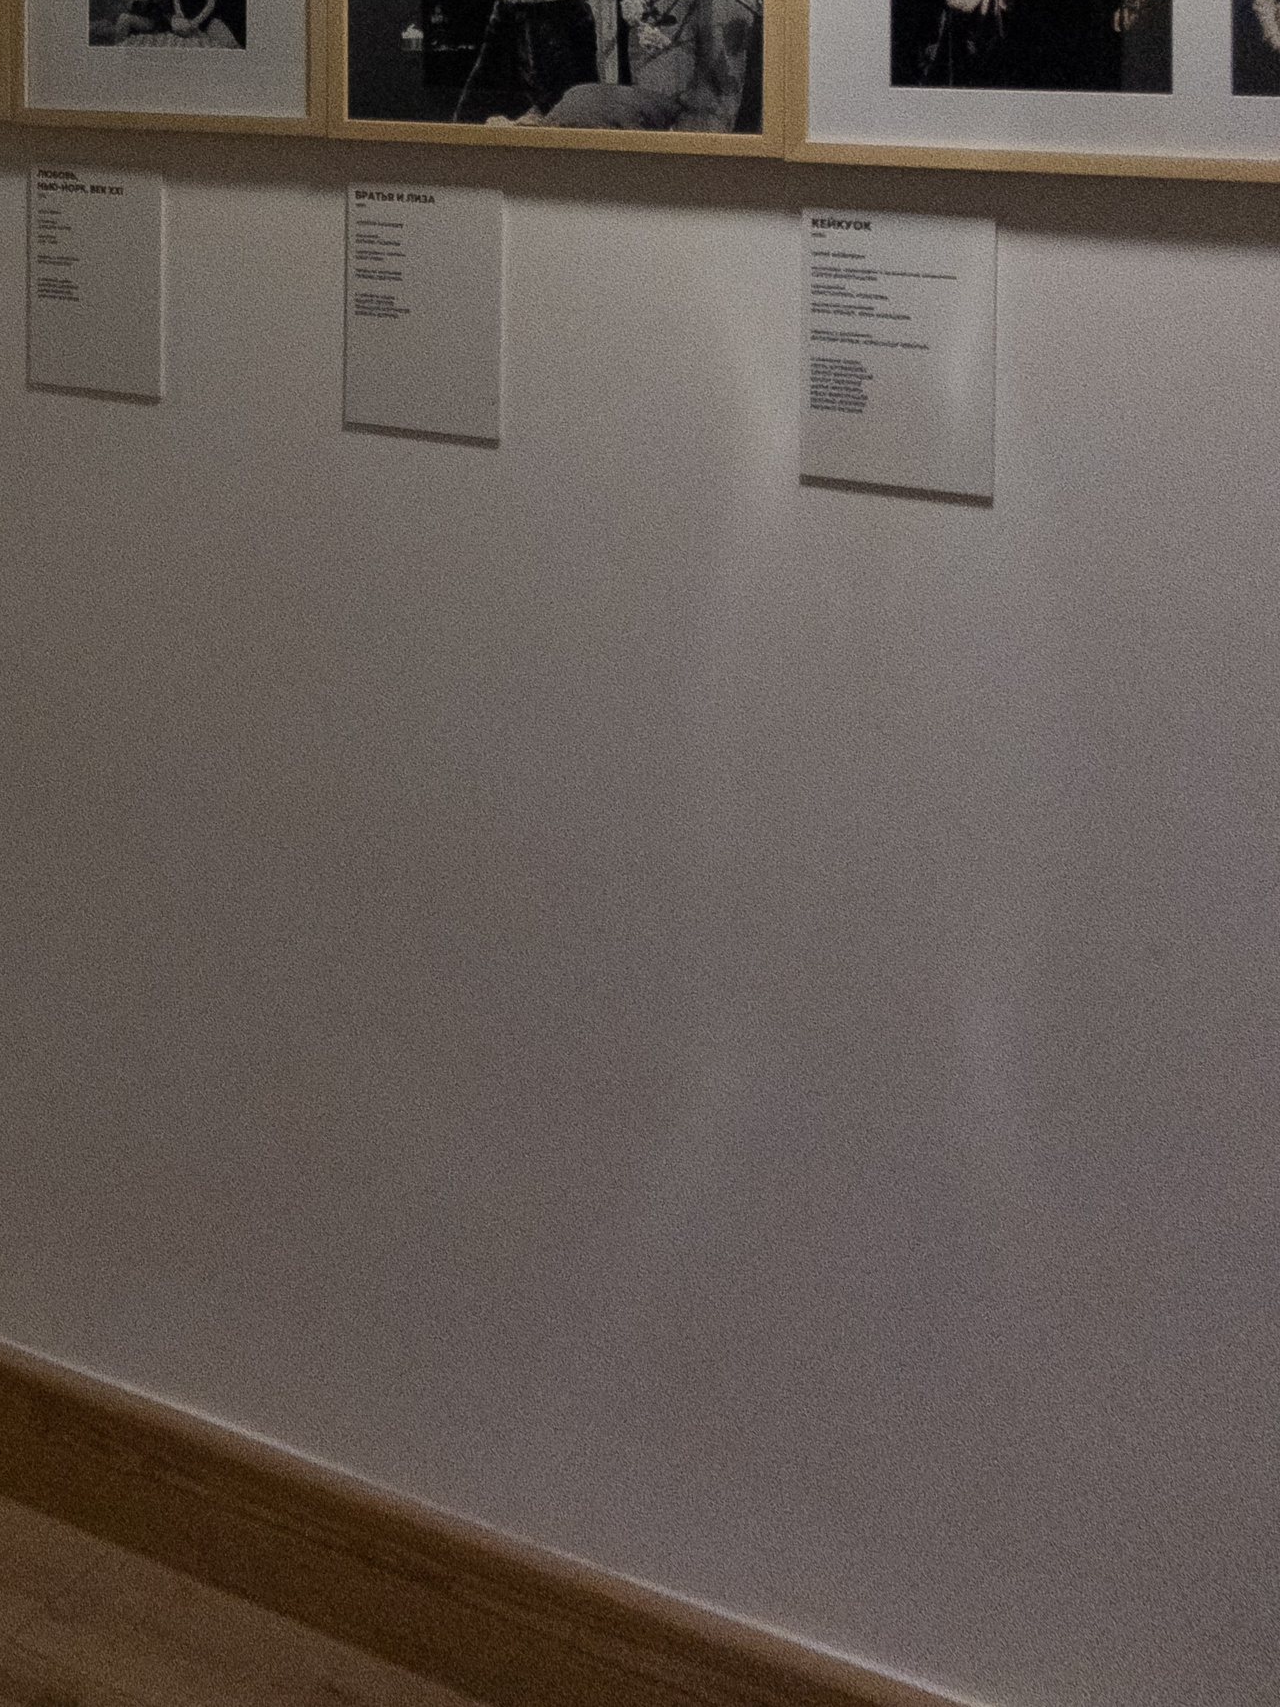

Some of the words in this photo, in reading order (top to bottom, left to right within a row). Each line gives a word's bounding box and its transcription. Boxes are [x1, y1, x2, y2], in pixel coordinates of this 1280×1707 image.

[89, 184, 106, 195] ВЕК
[355, 190, 395, 202] БРАТЬЯ
[397, 194, 405, 203] И
[406, 194, 435, 204] ЛИЗА
[811, 217, 872, 231] КЕЙКУОК
